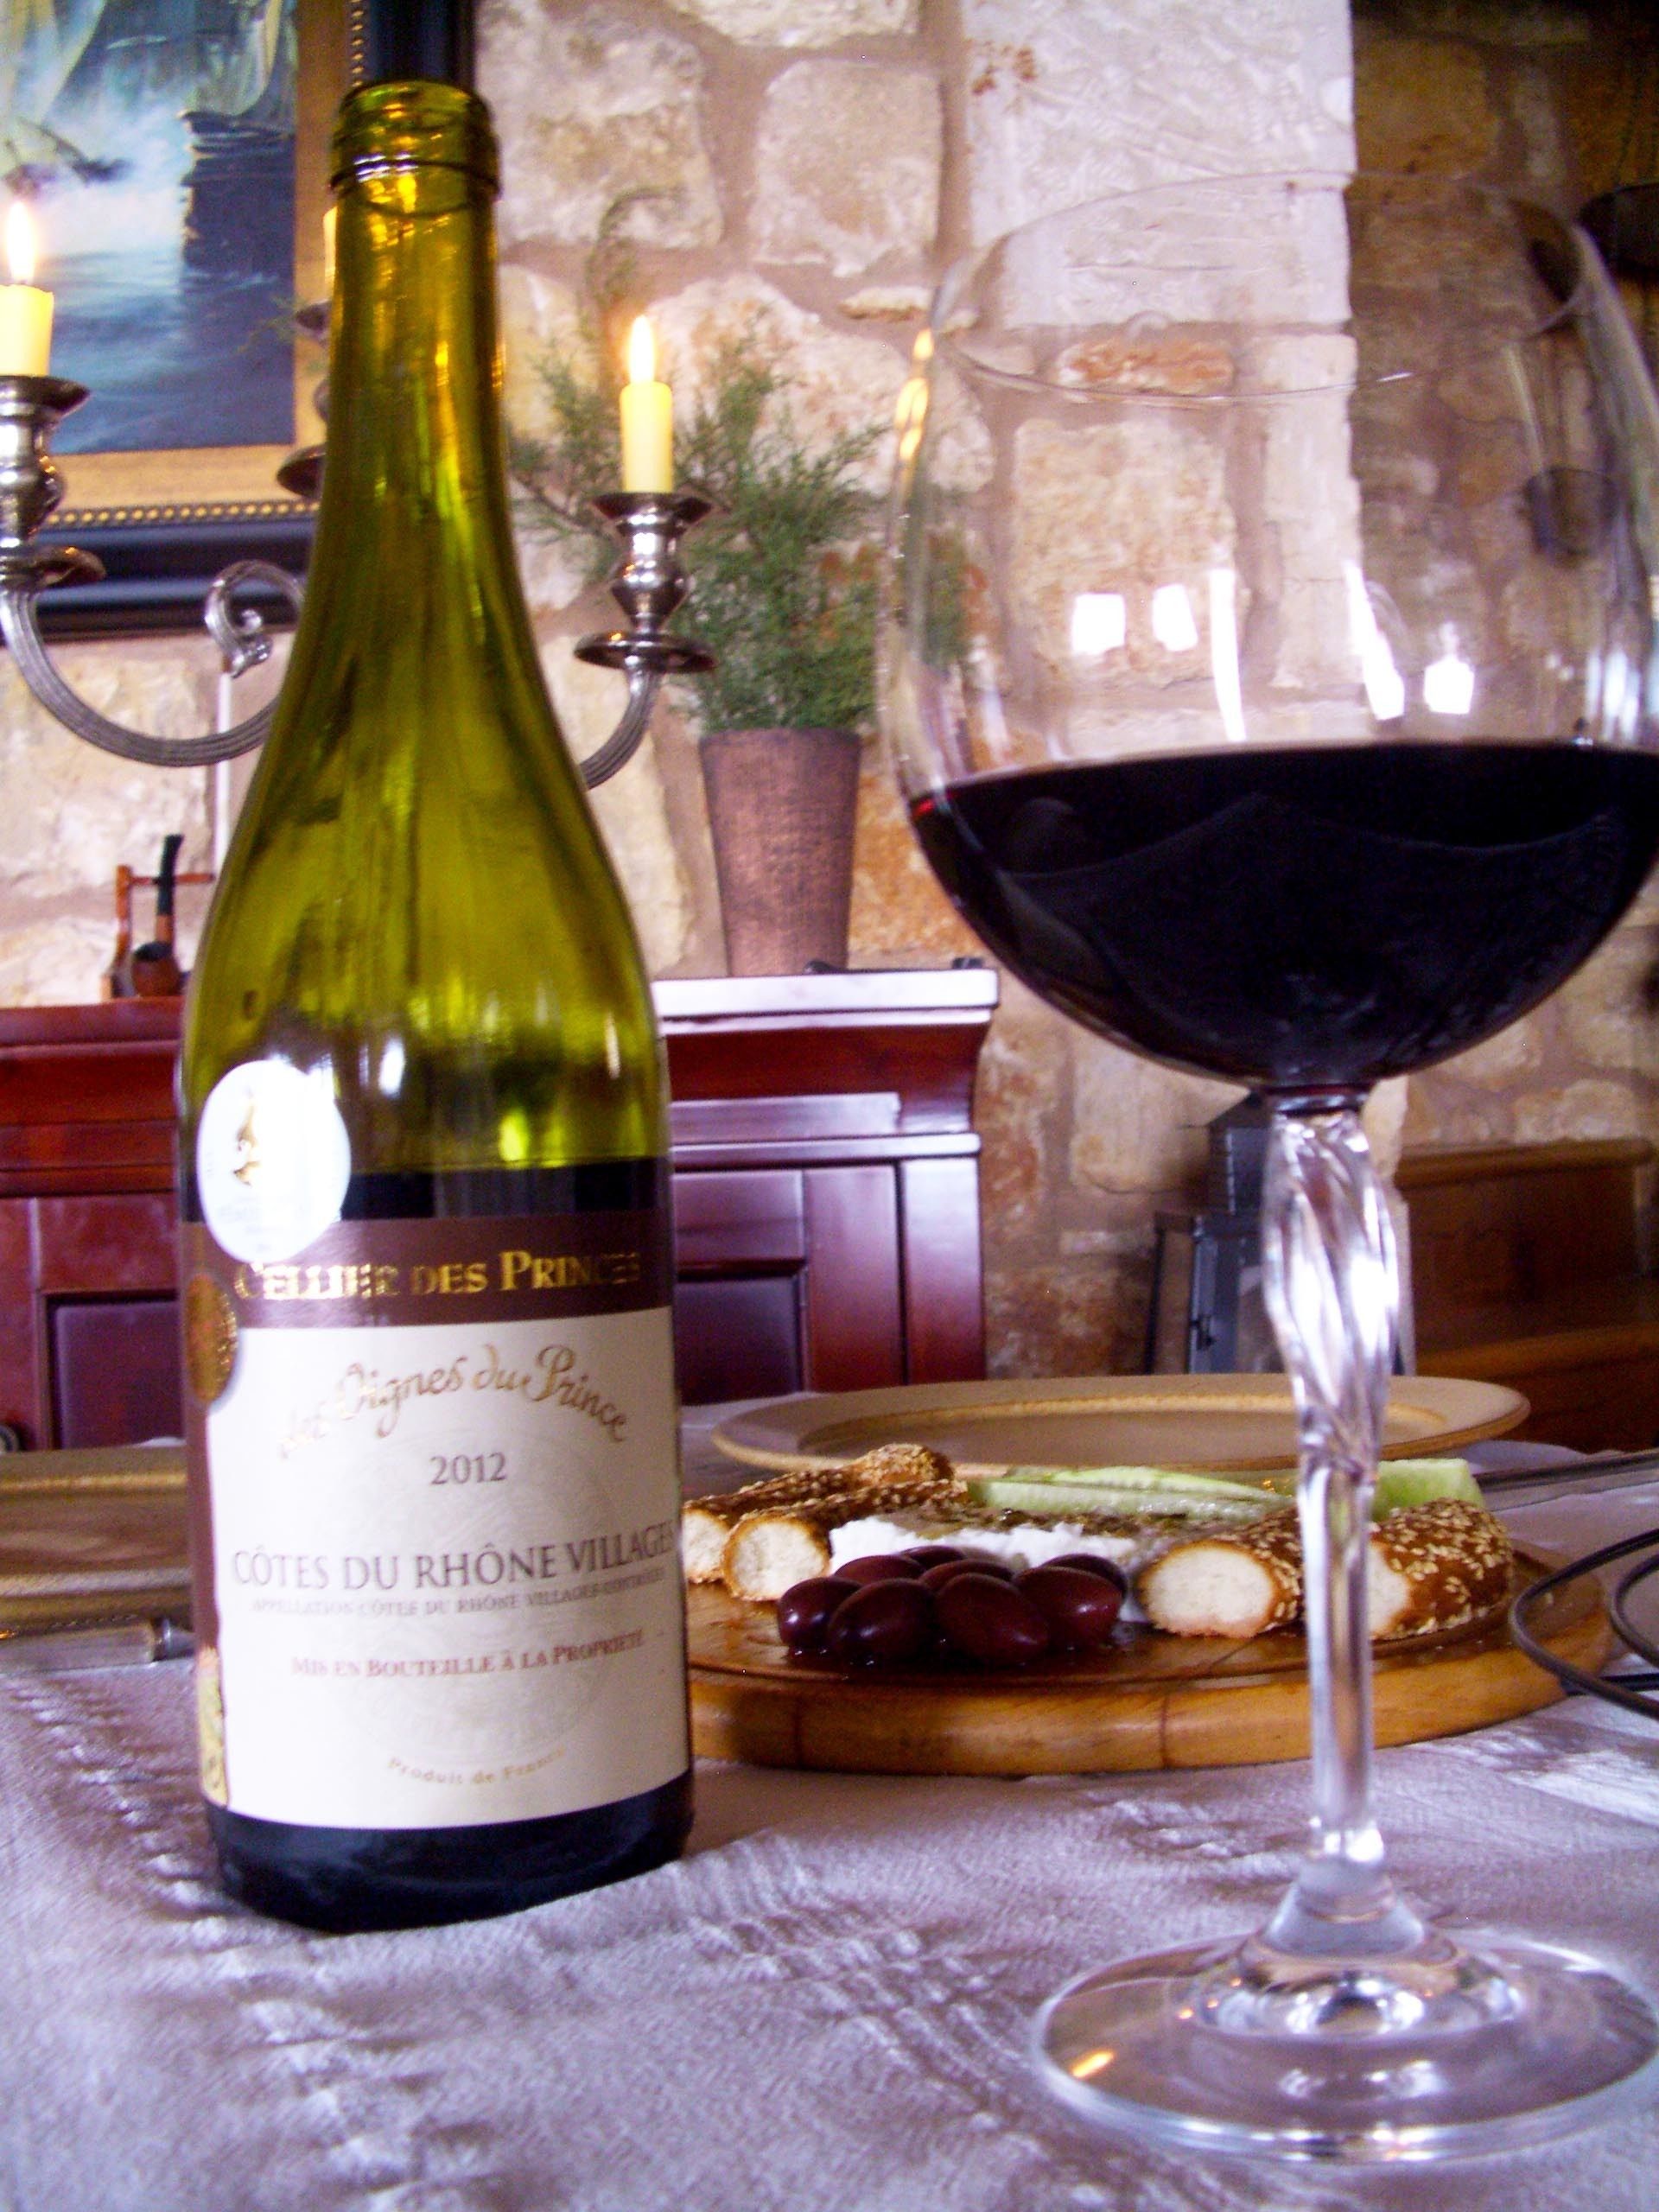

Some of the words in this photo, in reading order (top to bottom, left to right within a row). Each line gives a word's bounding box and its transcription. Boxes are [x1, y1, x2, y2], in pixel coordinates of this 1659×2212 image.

[410, 1262, 487, 1294] DES
[499, 1250, 641, 1291] PRINES
[335, 1356, 467, 1438] Vignes
[474, 1344, 518, 1391] du
[520, 1344, 626, 1442] Prince
[430, 1452, 507, 1485] 2012
[233, 1544, 329, 1589] CÔTES
[344, 1554, 398, 1590] DU
[415, 1541, 556, 1589] RHÔNE
[425, 1599, 450, 1615] DU
[472, 1770, 495, 1784] de
